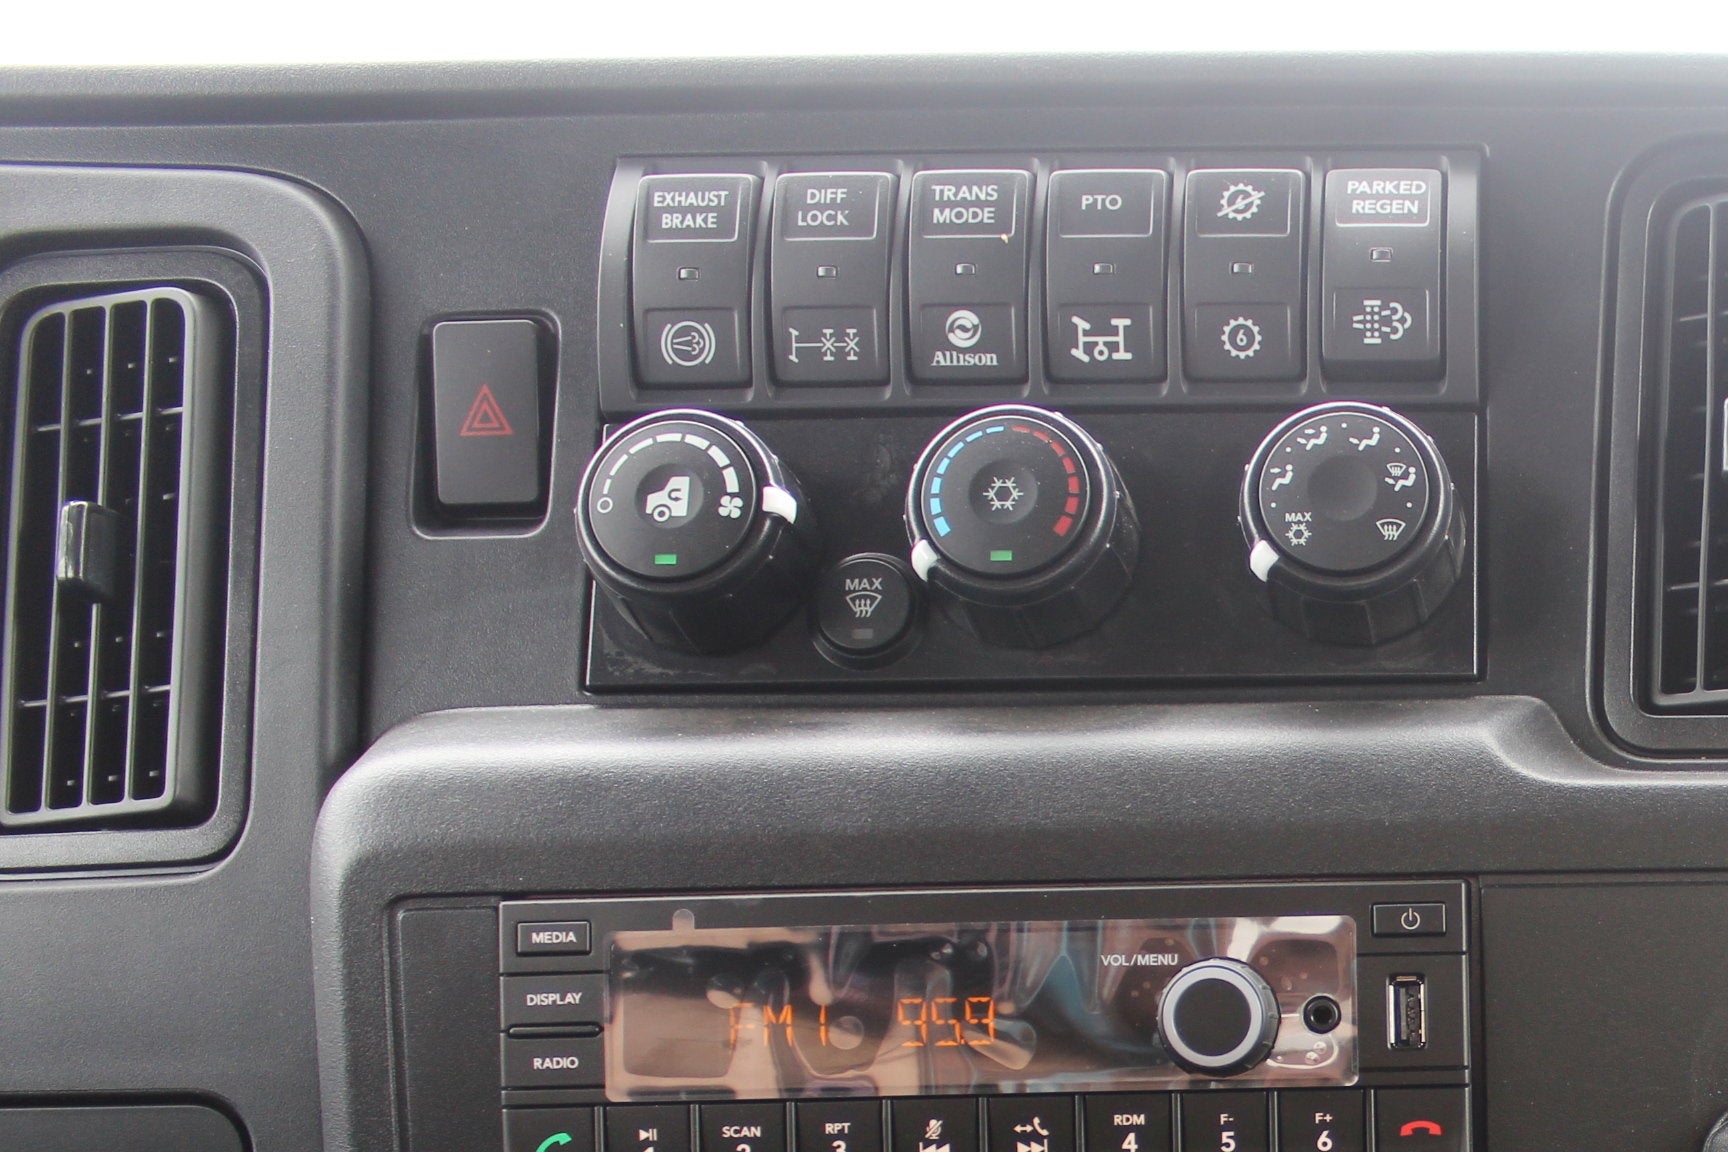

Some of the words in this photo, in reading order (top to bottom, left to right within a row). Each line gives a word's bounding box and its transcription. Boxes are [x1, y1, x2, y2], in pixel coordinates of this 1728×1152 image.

[931, 184, 998, 201] TRANS
[1346, 179, 1427, 196] PARKED
[653, 190, 729, 207] EXHAUST
[806, 188, 848, 204] DIFF
[1081, 194, 1122, 210] PTO
[1351, 199, 1419, 214] REGEN
[661, 212, 718, 229] BRAKE
[797, 209, 849, 226] LOCK
[932, 207, 995, 224] MODE
[1236, 325, 1248, 346] 6
[931, 350, 998, 367] Allison
[1285, 511, 1312, 523] MAX
[844, 577, 884, 591] MAX
[531, 931, 577, 944] MEDIA
[1100, 953, 1178, 967] VOL/MENU
[526, 992, 583, 1006] DISPLAY
[533, 1056, 579, 1070] RADIO
[1113, 1113, 1145, 1126] RDM
[1220, 1113, 1234, 1125] F-
[1315, 1112, 1333, 1124] F+
[722, 1125, 762, 1138] SCAN
[825, 1122, 851, 1135] RPT
[1220, 1131, 1236, 1152] 5
[1316, 1130, 1333, 1152] 6
